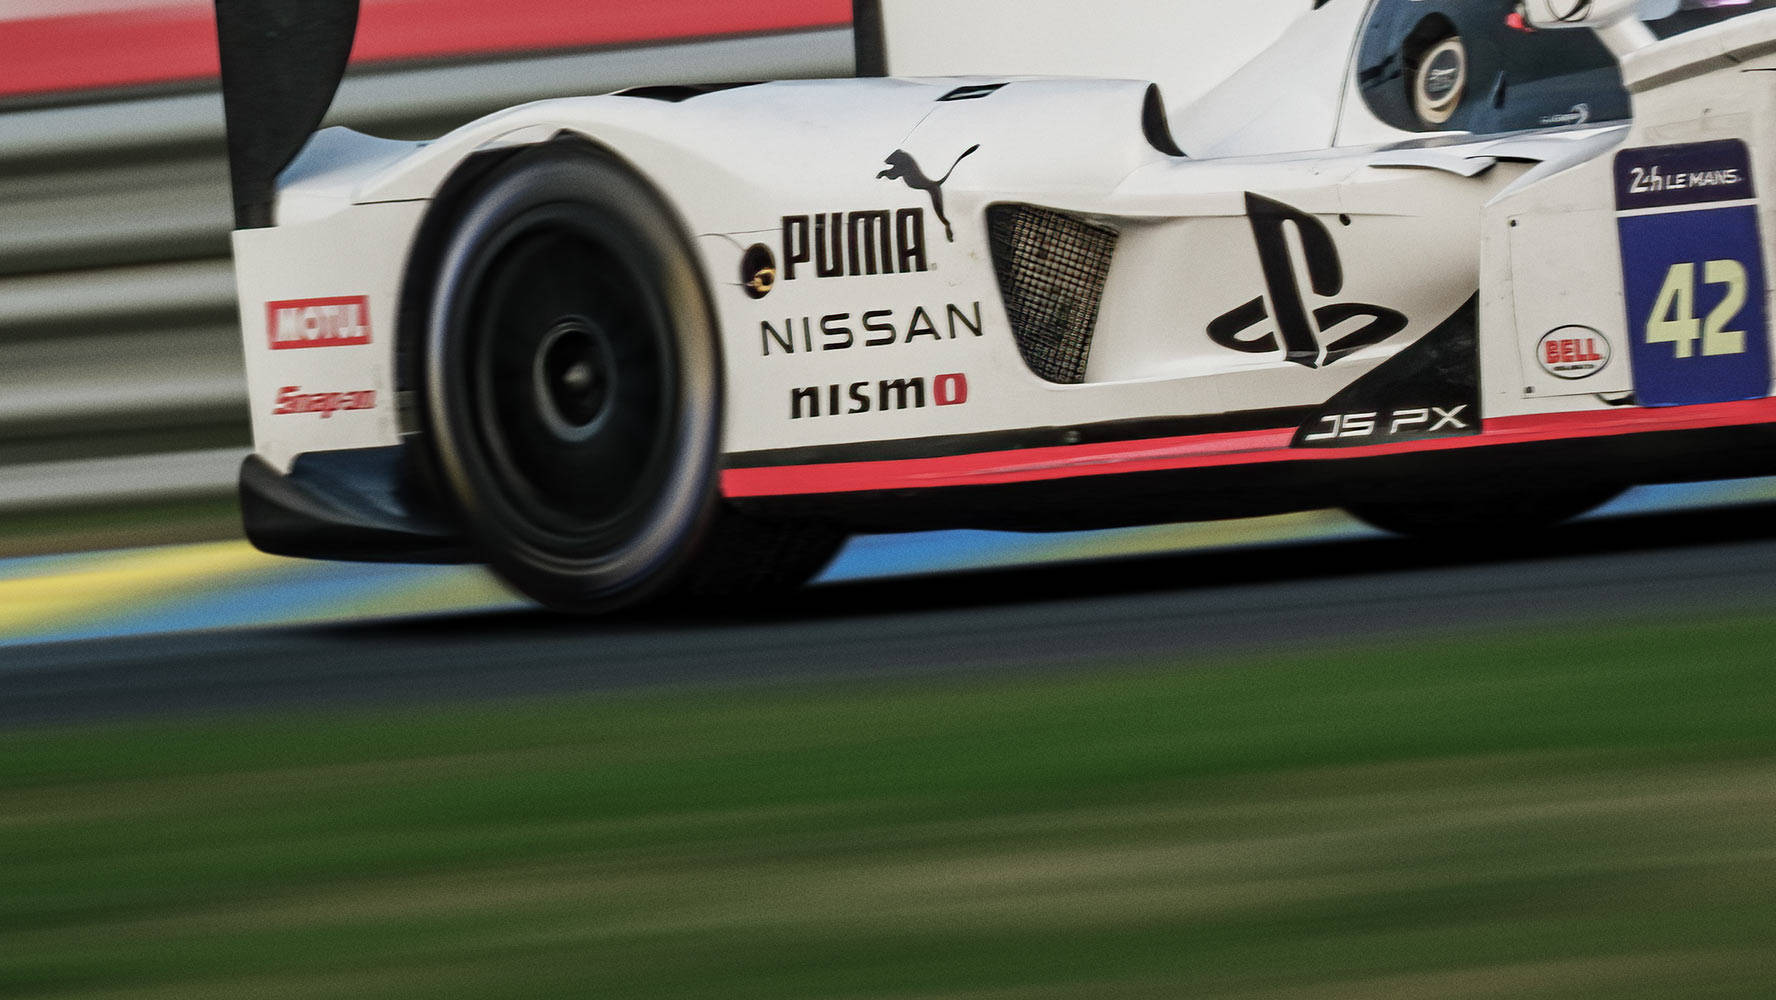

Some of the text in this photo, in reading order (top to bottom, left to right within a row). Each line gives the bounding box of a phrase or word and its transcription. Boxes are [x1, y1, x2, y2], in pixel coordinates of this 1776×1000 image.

[1665, 173, 1688, 190] LE
[1689, 168, 1742, 188] MANS
[782, 207, 929, 281] PUMA
[276, 303, 370, 342] MOTUL
[1645, 258, 1748, 360] 42
[760, 301, 984, 357] NISSAN
[1544, 338, 1603, 365] BELL
[1304, 404, 1469, 441] JS PX
